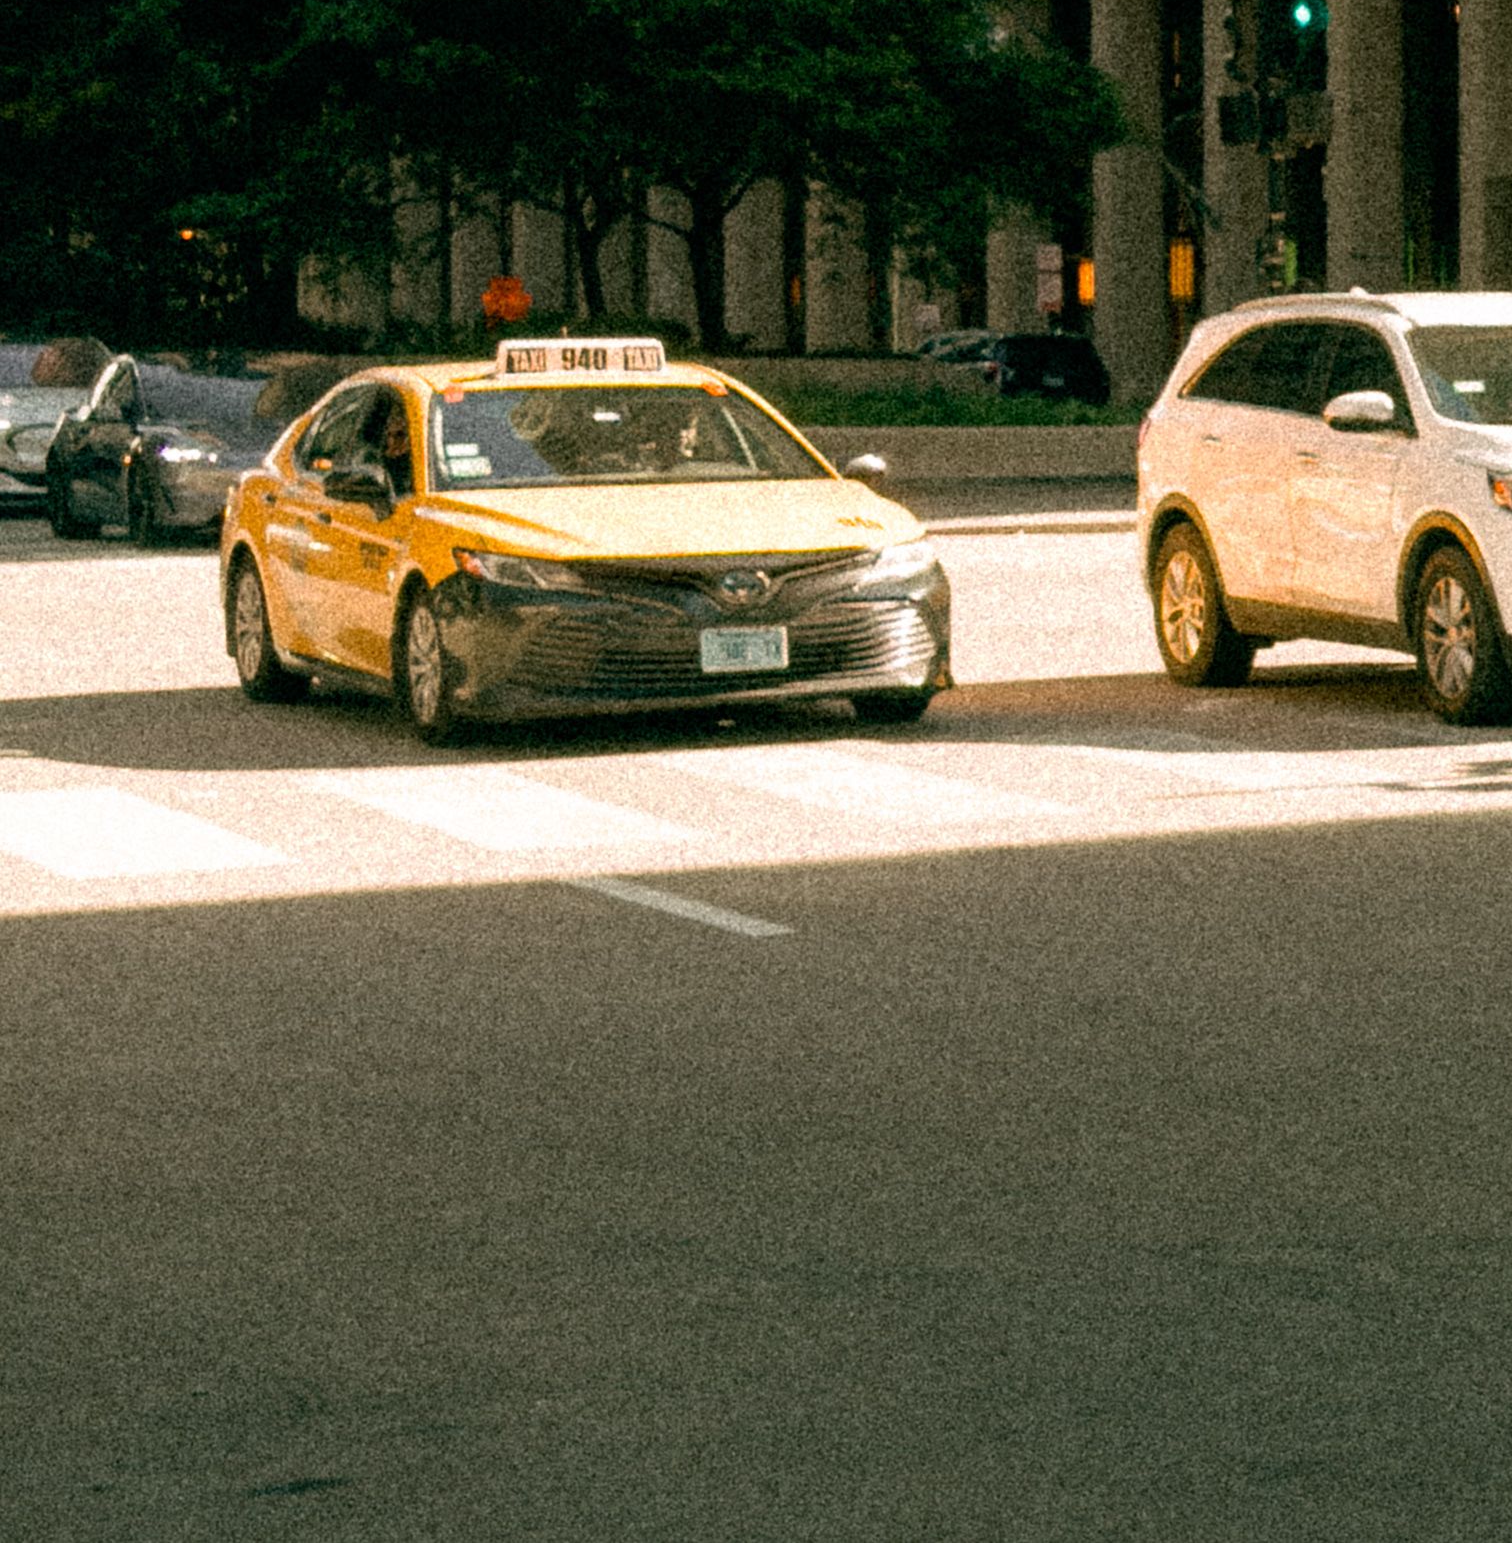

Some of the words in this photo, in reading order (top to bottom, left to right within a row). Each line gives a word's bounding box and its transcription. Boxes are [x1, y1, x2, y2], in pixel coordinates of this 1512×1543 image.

[512, 348, 547, 373] TAXI
[561, 347, 608, 371] 940
[626, 347, 660, 371] TAXI
